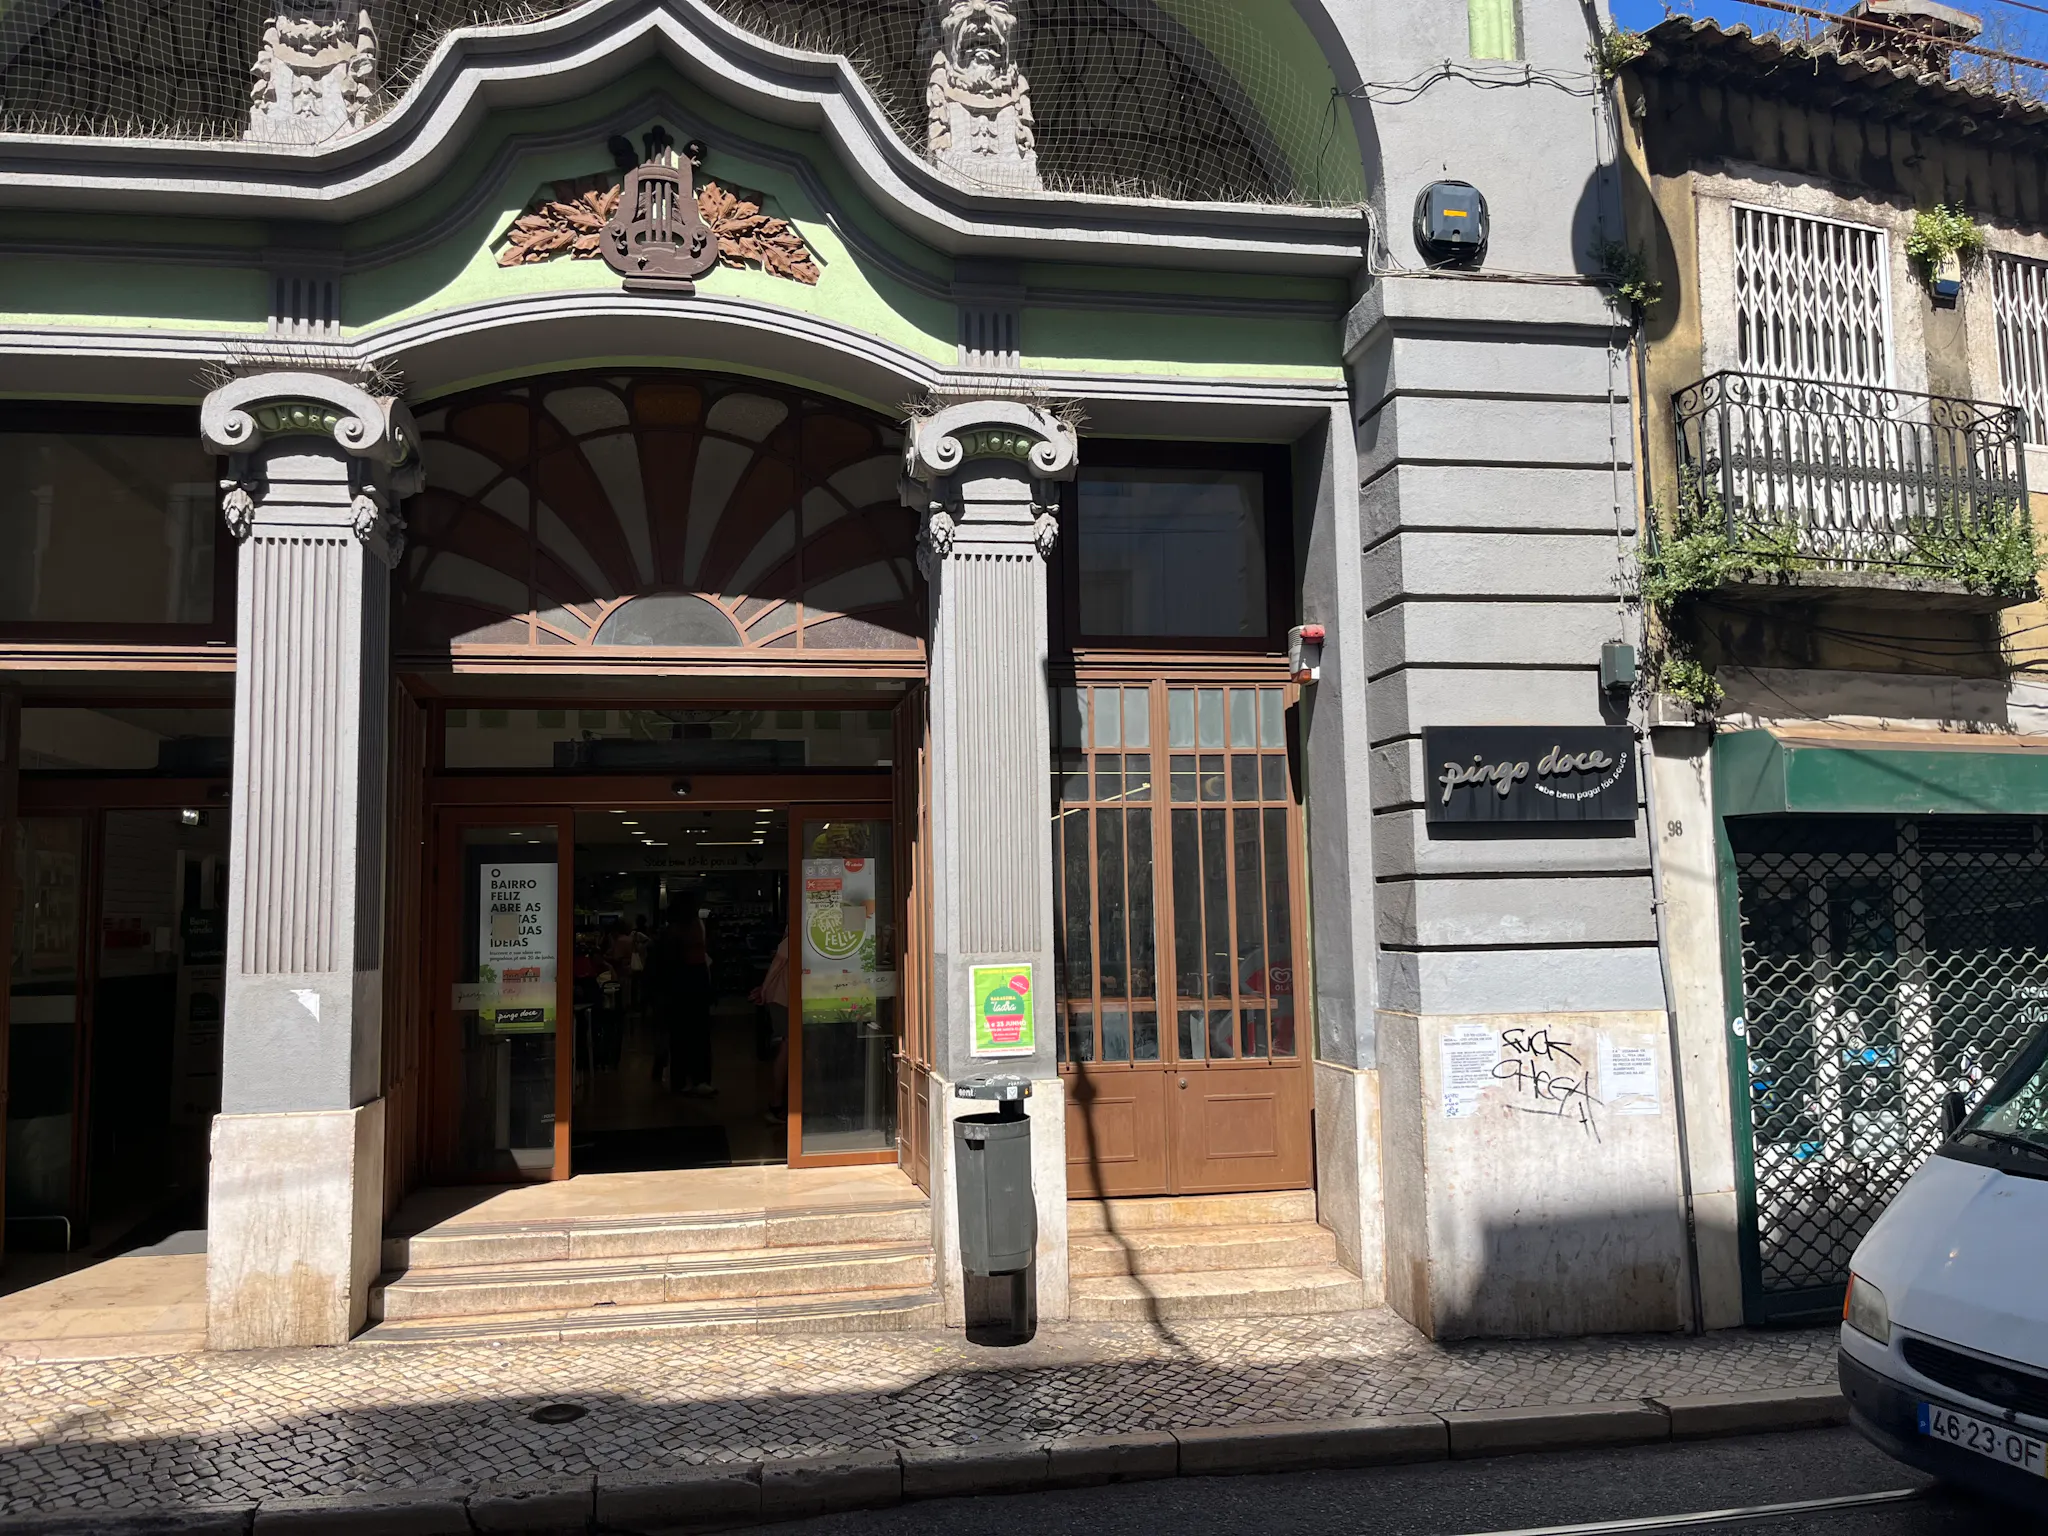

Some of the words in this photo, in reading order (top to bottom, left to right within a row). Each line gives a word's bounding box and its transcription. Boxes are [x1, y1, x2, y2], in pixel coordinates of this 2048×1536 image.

[1438, 754, 1530, 804] pingo
[1537, 745, 1613, 775] doce
[1534, 782, 1555, 796] sabe
[1556, 789, 1576, 799] bem
[1576, 786, 1601, 801] pagar
[1600, 776, 1614, 791] tão
[1612, 751, 1628, 780] pouco
[1667, 820, 1683, 837] 98
[491, 868, 501, 878] O
[491, 879, 537, 889] BAIRRO
[490, 891, 521, 901] FELIZ
[490, 903, 521, 913] ABRE
[525, 902, 542, 912] AS
[490, 937, 529, 948] IDEIAS
